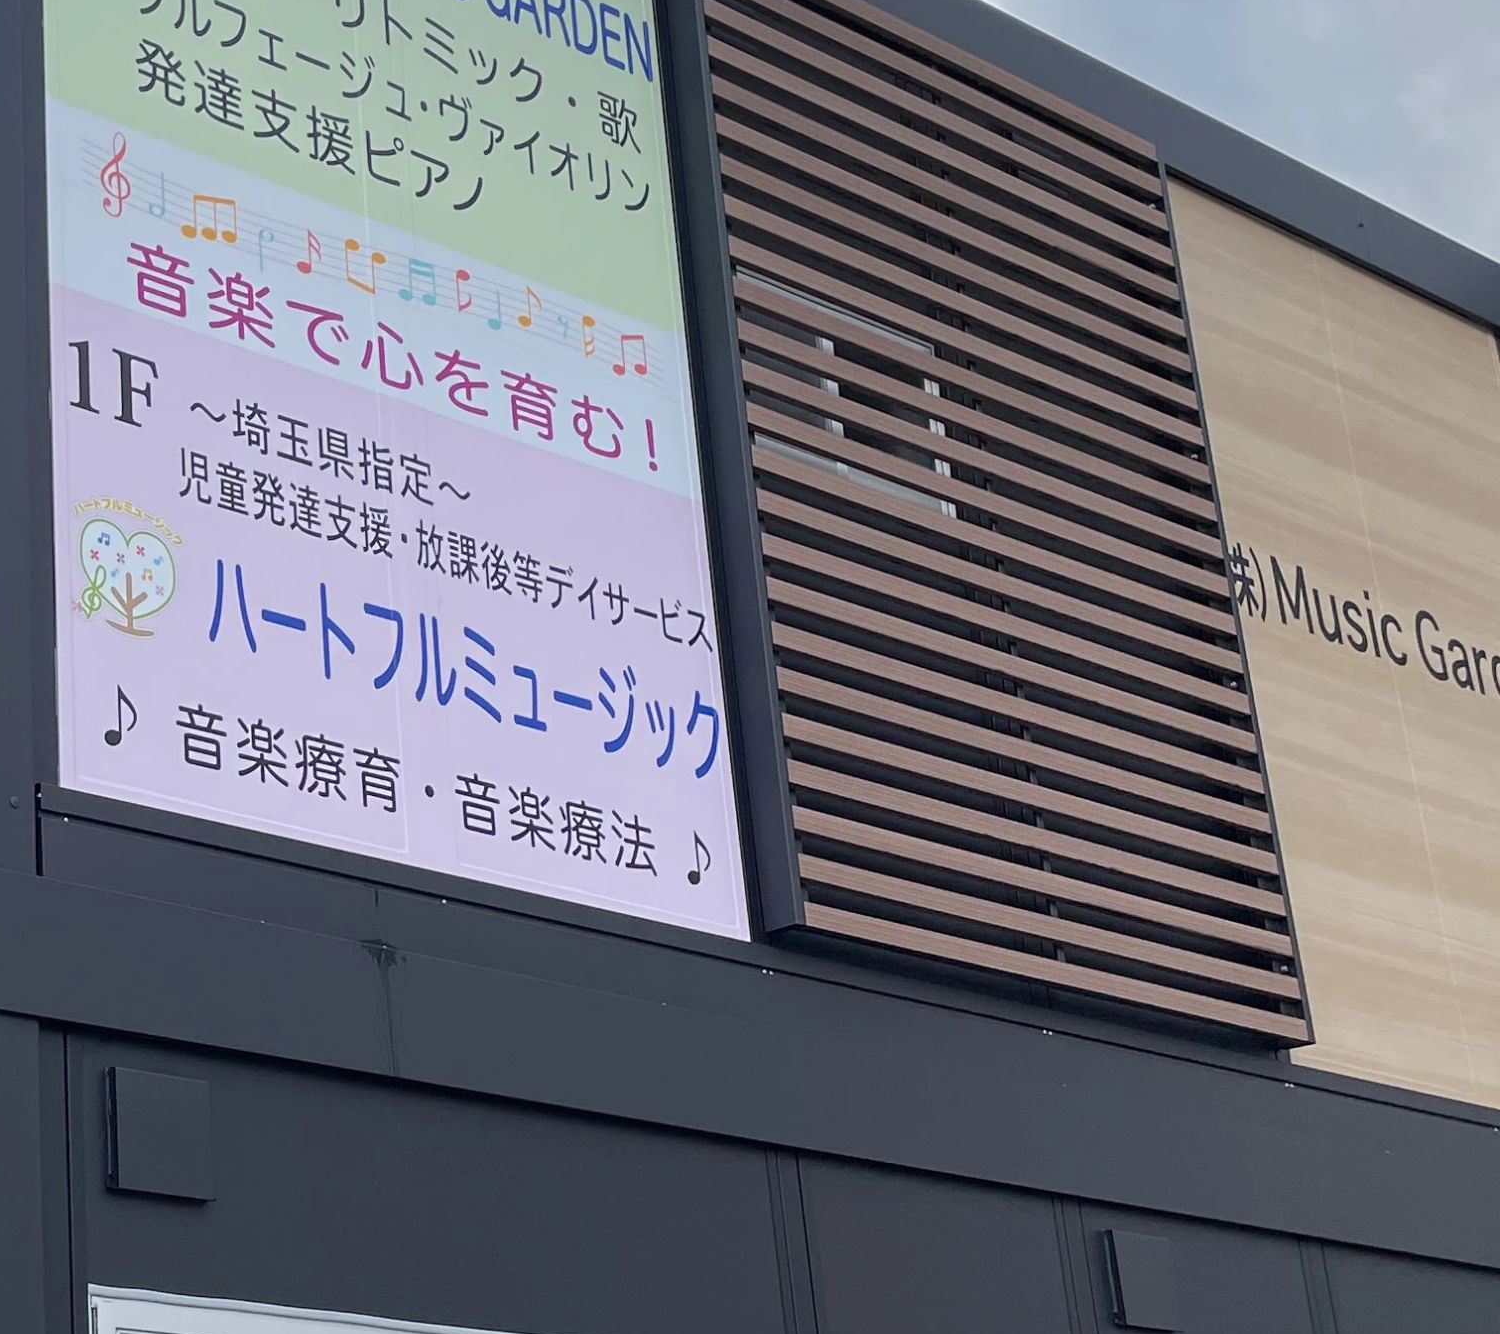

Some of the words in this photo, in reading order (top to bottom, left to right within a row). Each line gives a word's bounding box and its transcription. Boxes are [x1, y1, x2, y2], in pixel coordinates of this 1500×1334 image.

[135, 38, 485, 212] 発達支援ピアノ
[67, 340, 160, 429] 1F
[208, 559, 722, 779] ハートフルミュージック
